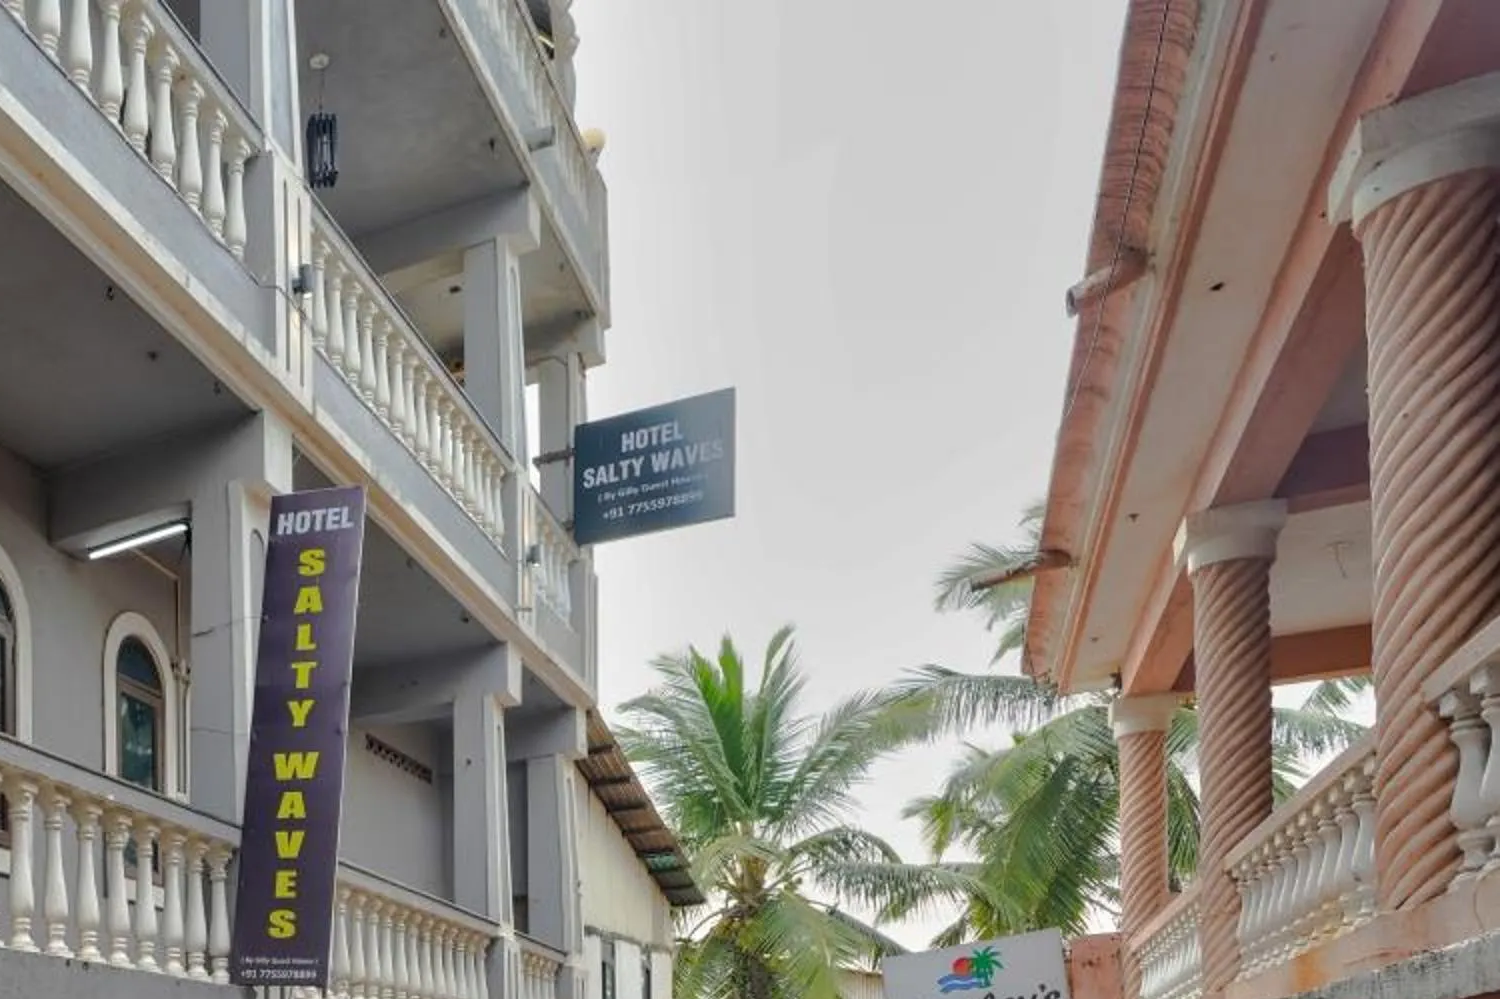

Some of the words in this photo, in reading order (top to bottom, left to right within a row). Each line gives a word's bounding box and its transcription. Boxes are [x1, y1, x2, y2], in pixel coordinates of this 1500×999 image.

[621, 420, 684, 453] HOTEL
[583, 455, 645, 489] SALTY
[651, 438, 725, 473] WAVES
[277, 506, 354, 536] HOTEL
[287, 549, 326, 728] SALTY
[267, 751, 320, 939] WAVES
